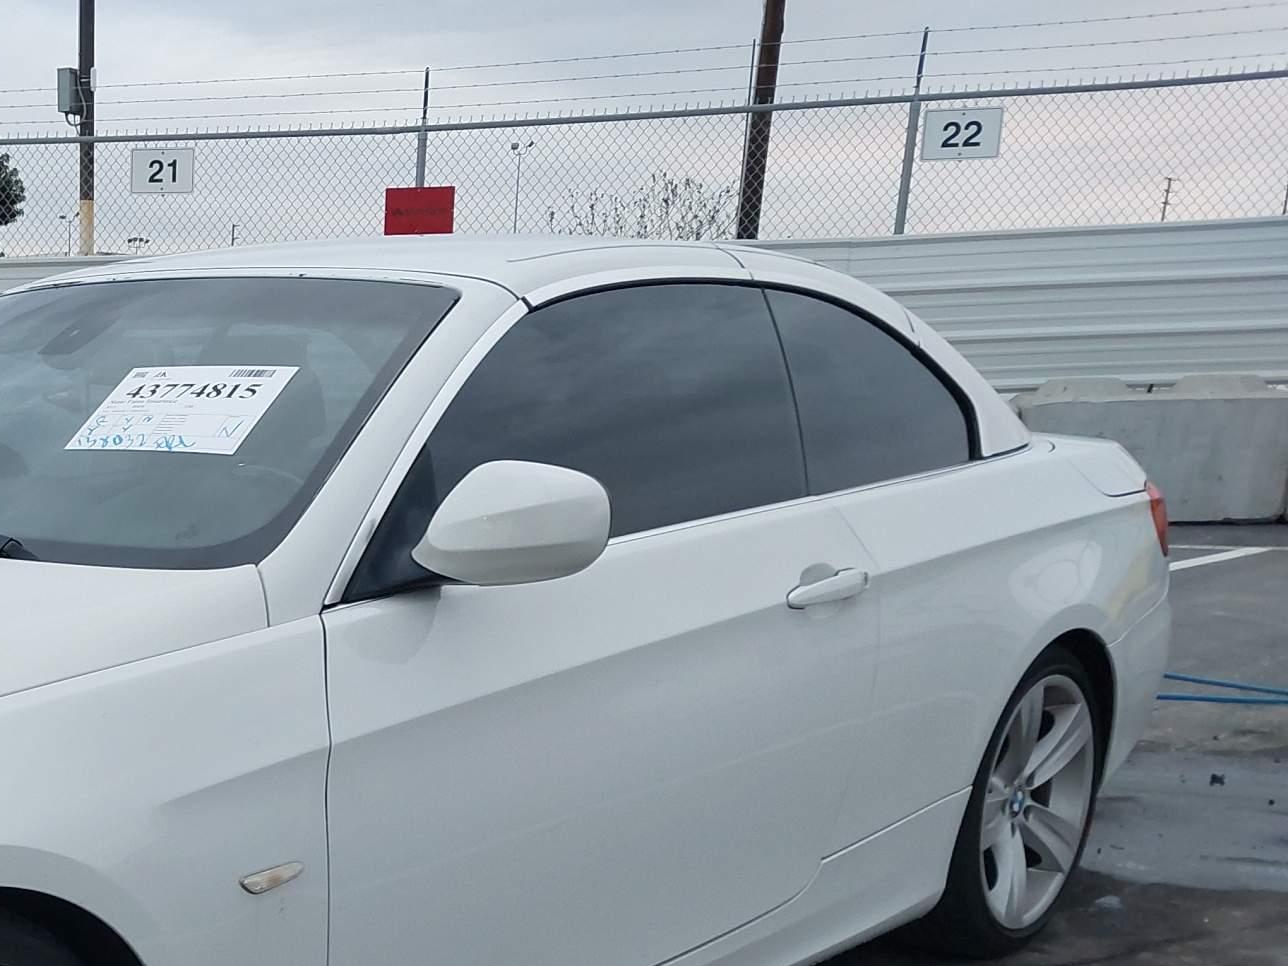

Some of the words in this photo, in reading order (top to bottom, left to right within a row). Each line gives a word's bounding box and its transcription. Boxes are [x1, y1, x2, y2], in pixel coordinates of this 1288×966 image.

[940, 120, 983, 148] 22
[148, 159, 177, 183] 21
[126, 383, 263, 399] 43774815
